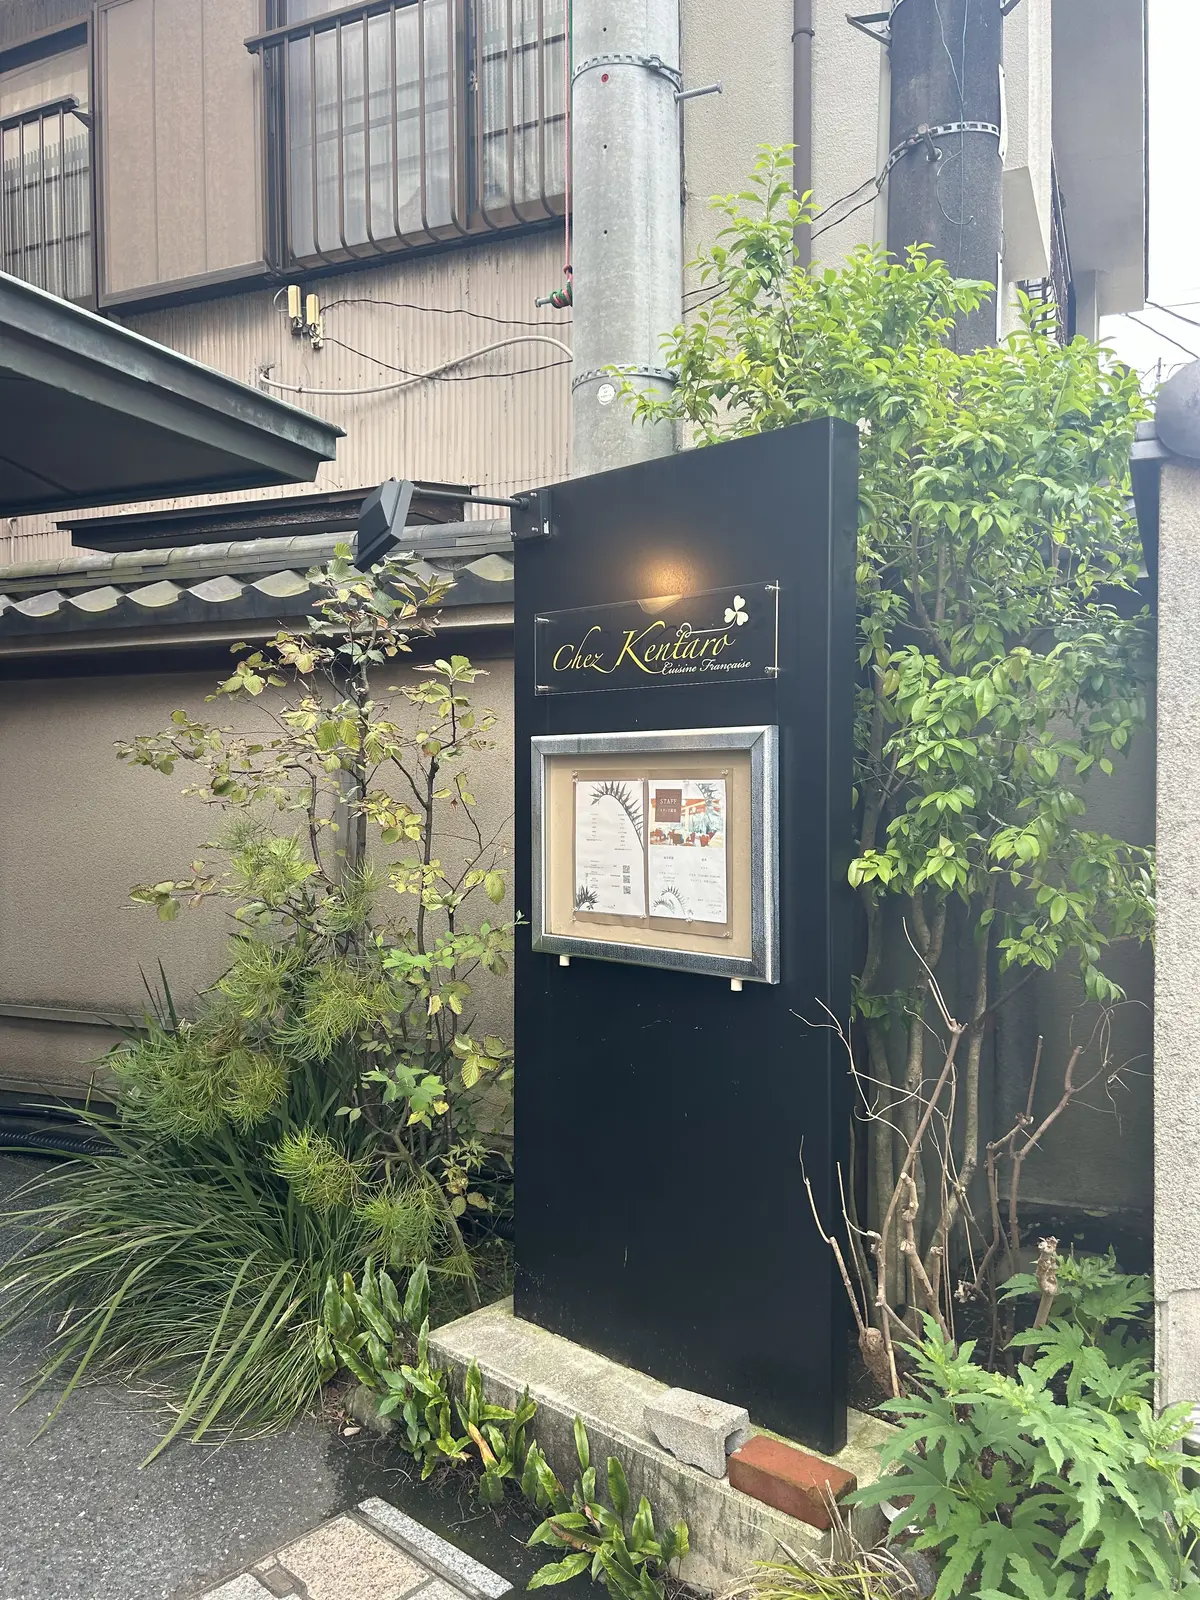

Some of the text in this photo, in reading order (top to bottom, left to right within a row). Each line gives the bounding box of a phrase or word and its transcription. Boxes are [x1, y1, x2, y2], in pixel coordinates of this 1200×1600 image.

[552, 620, 736, 674] Chez Kentaro
[661, 658, 752, 676] Cuisine Française
